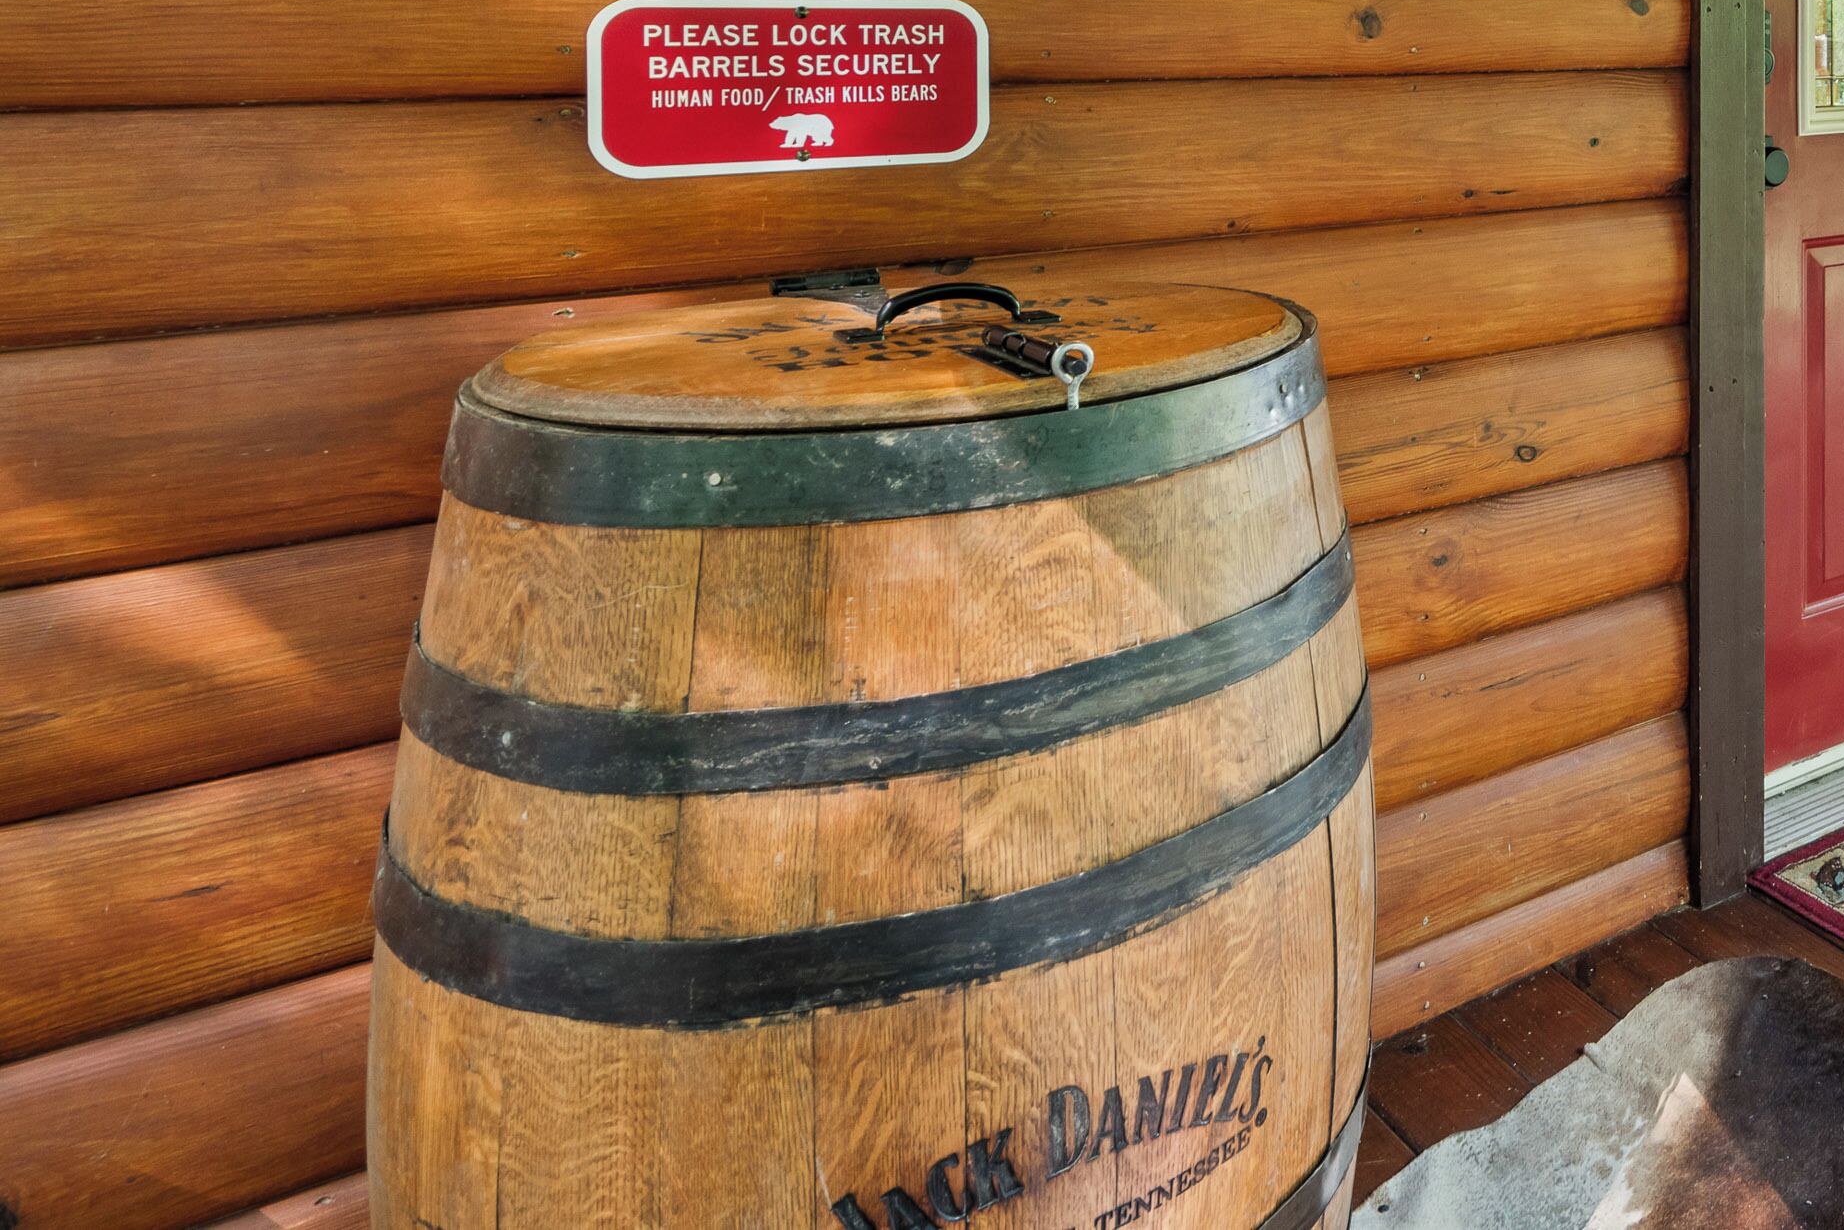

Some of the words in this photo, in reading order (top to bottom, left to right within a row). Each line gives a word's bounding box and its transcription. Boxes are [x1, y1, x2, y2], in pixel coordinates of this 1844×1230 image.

[643, 24, 759, 48] PLEASE
[771, 24, 847, 47] LOCK
[858, 24, 945, 45] TRASH
[648, 54, 786, 80] BARRELS
[797, 53, 941, 77] SECURELY
[651, 89, 713, 109] HUMAN
[786, 86, 836, 105] TRASH
[842, 85, 885, 103] KILLS
[891, 84, 938, 102] BEARS
[1094, 1125, 1251, 1230] TENNESSEE
